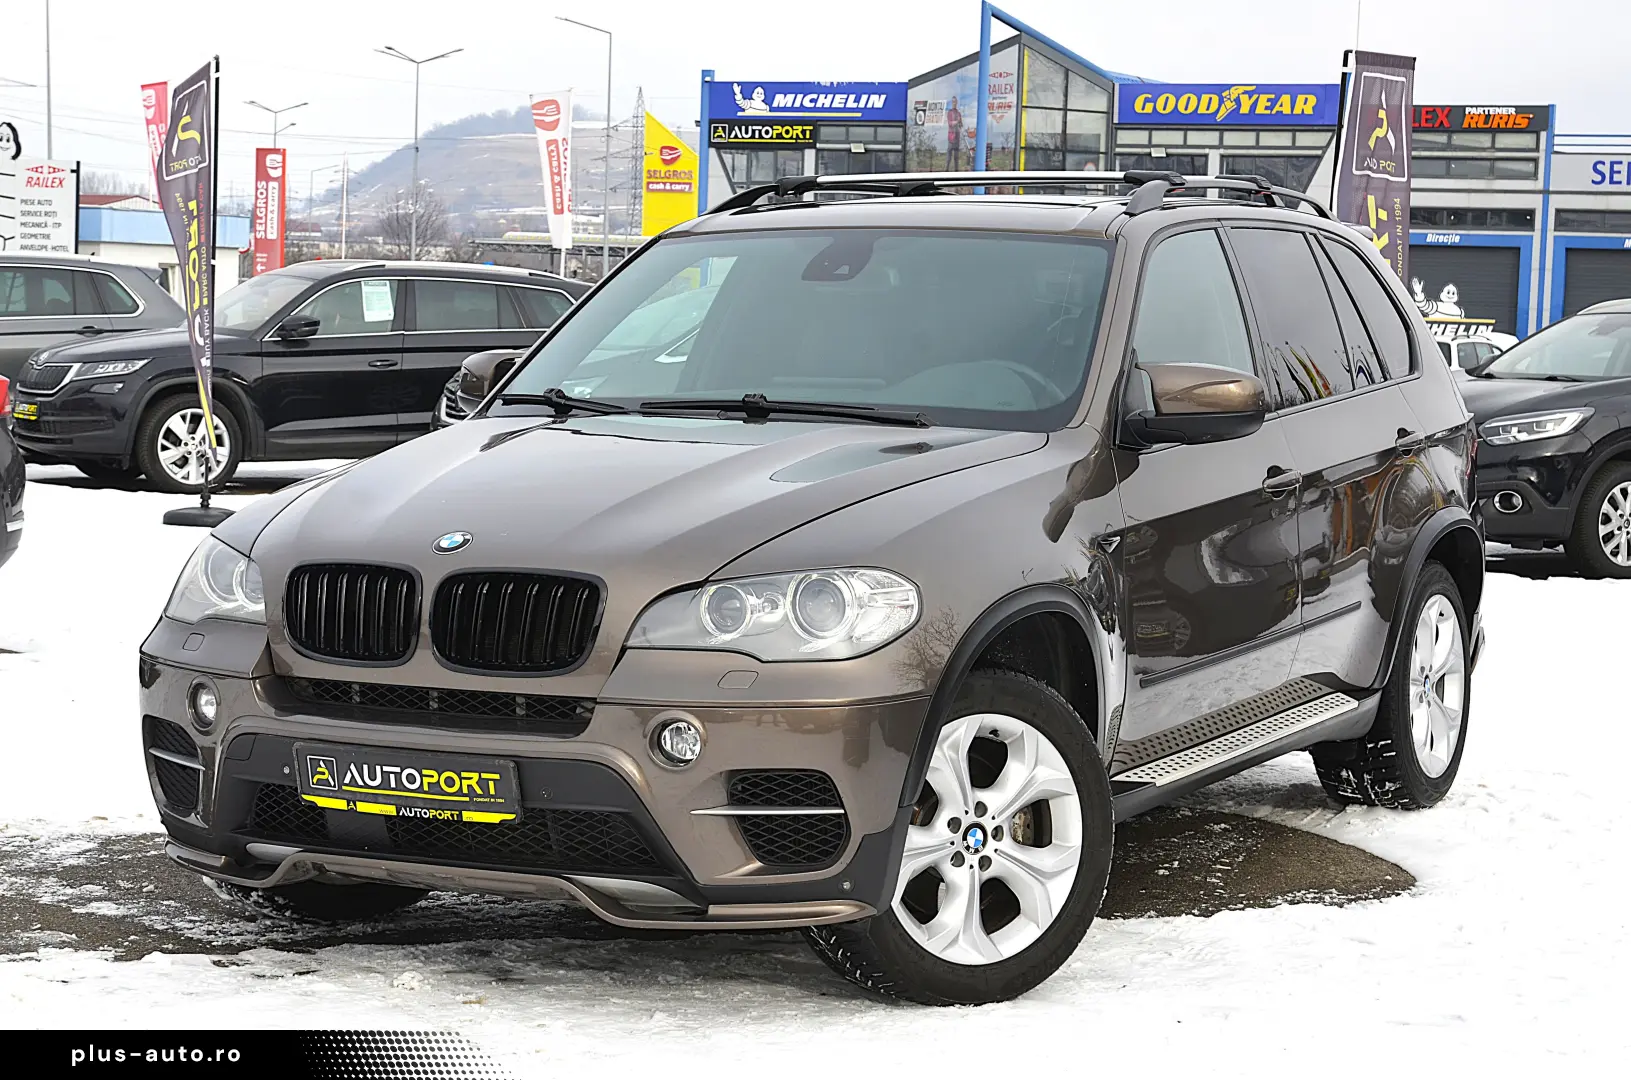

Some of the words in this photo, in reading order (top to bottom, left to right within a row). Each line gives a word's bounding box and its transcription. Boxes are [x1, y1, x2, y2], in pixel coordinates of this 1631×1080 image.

[772, 93, 887, 109] MICHELIN
[1411, 106, 1452, 128] LEX
[1465, 106, 1516, 115] PARTENER
[1462, 113, 1534, 129] RURIS
[729, 125, 813, 139] AUTOPORT
[646, 169, 693, 180] SELGROS
[25, 176, 66, 188] RAILEX
[648, 182, 665, 190] cash
[671, 183, 690, 192] carry
[20, 209, 43, 217] SERVICE
[256, 180, 267, 239] SELGROS
[1393, 197, 1402, 221] 1994
[1396, 225, 1402, 236] IN
[343, 762, 501, 795] AUTOPORT
[399, 807, 459, 821] AUTOPORT
